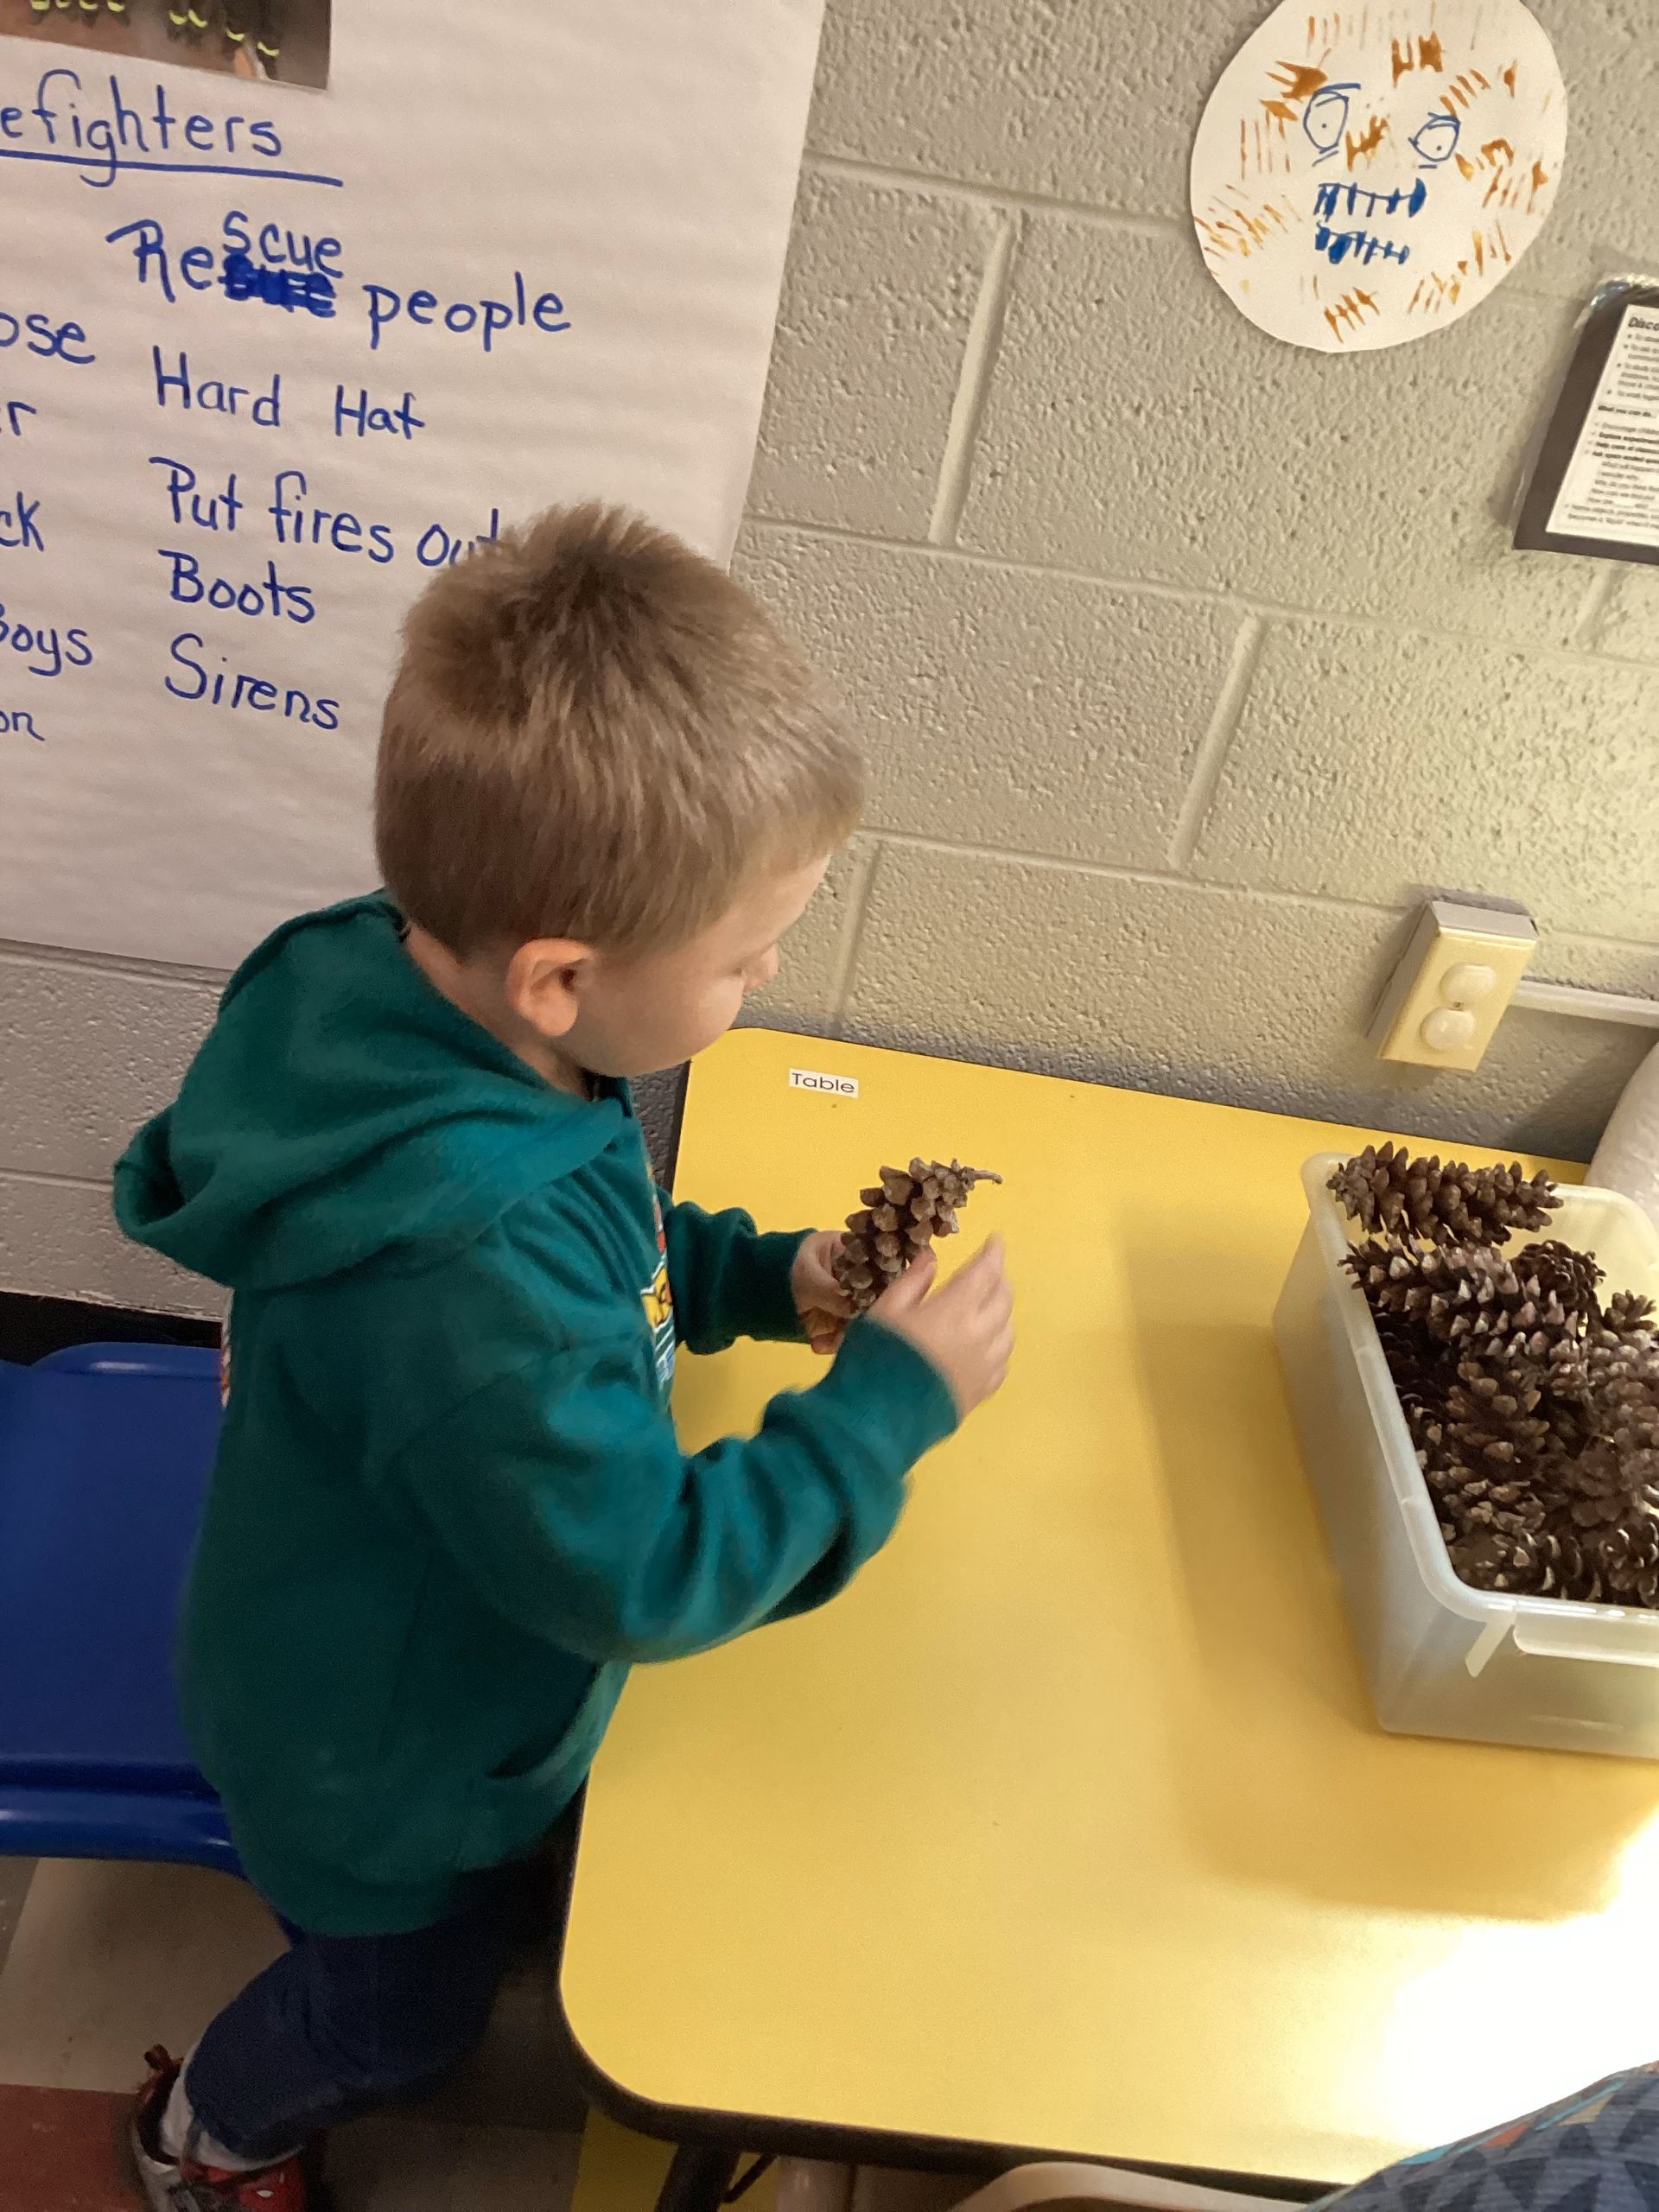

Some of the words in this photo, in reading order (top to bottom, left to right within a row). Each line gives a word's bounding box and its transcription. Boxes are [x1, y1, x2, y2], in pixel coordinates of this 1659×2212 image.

[0, 69, 283, 188] efighters
[105, 211, 344, 302] Rescue
[363, 272, 570, 352] people
[153, 346, 281, 427] Hard
[334, 385, 425, 439] Hat
[149, 456, 243, 531] Put
[268, 470, 395, 563] fires
[158, 550, 315, 624] Boots
[164, 632, 339, 730] Sirens
[791, 1072, 855, 1093] Table
